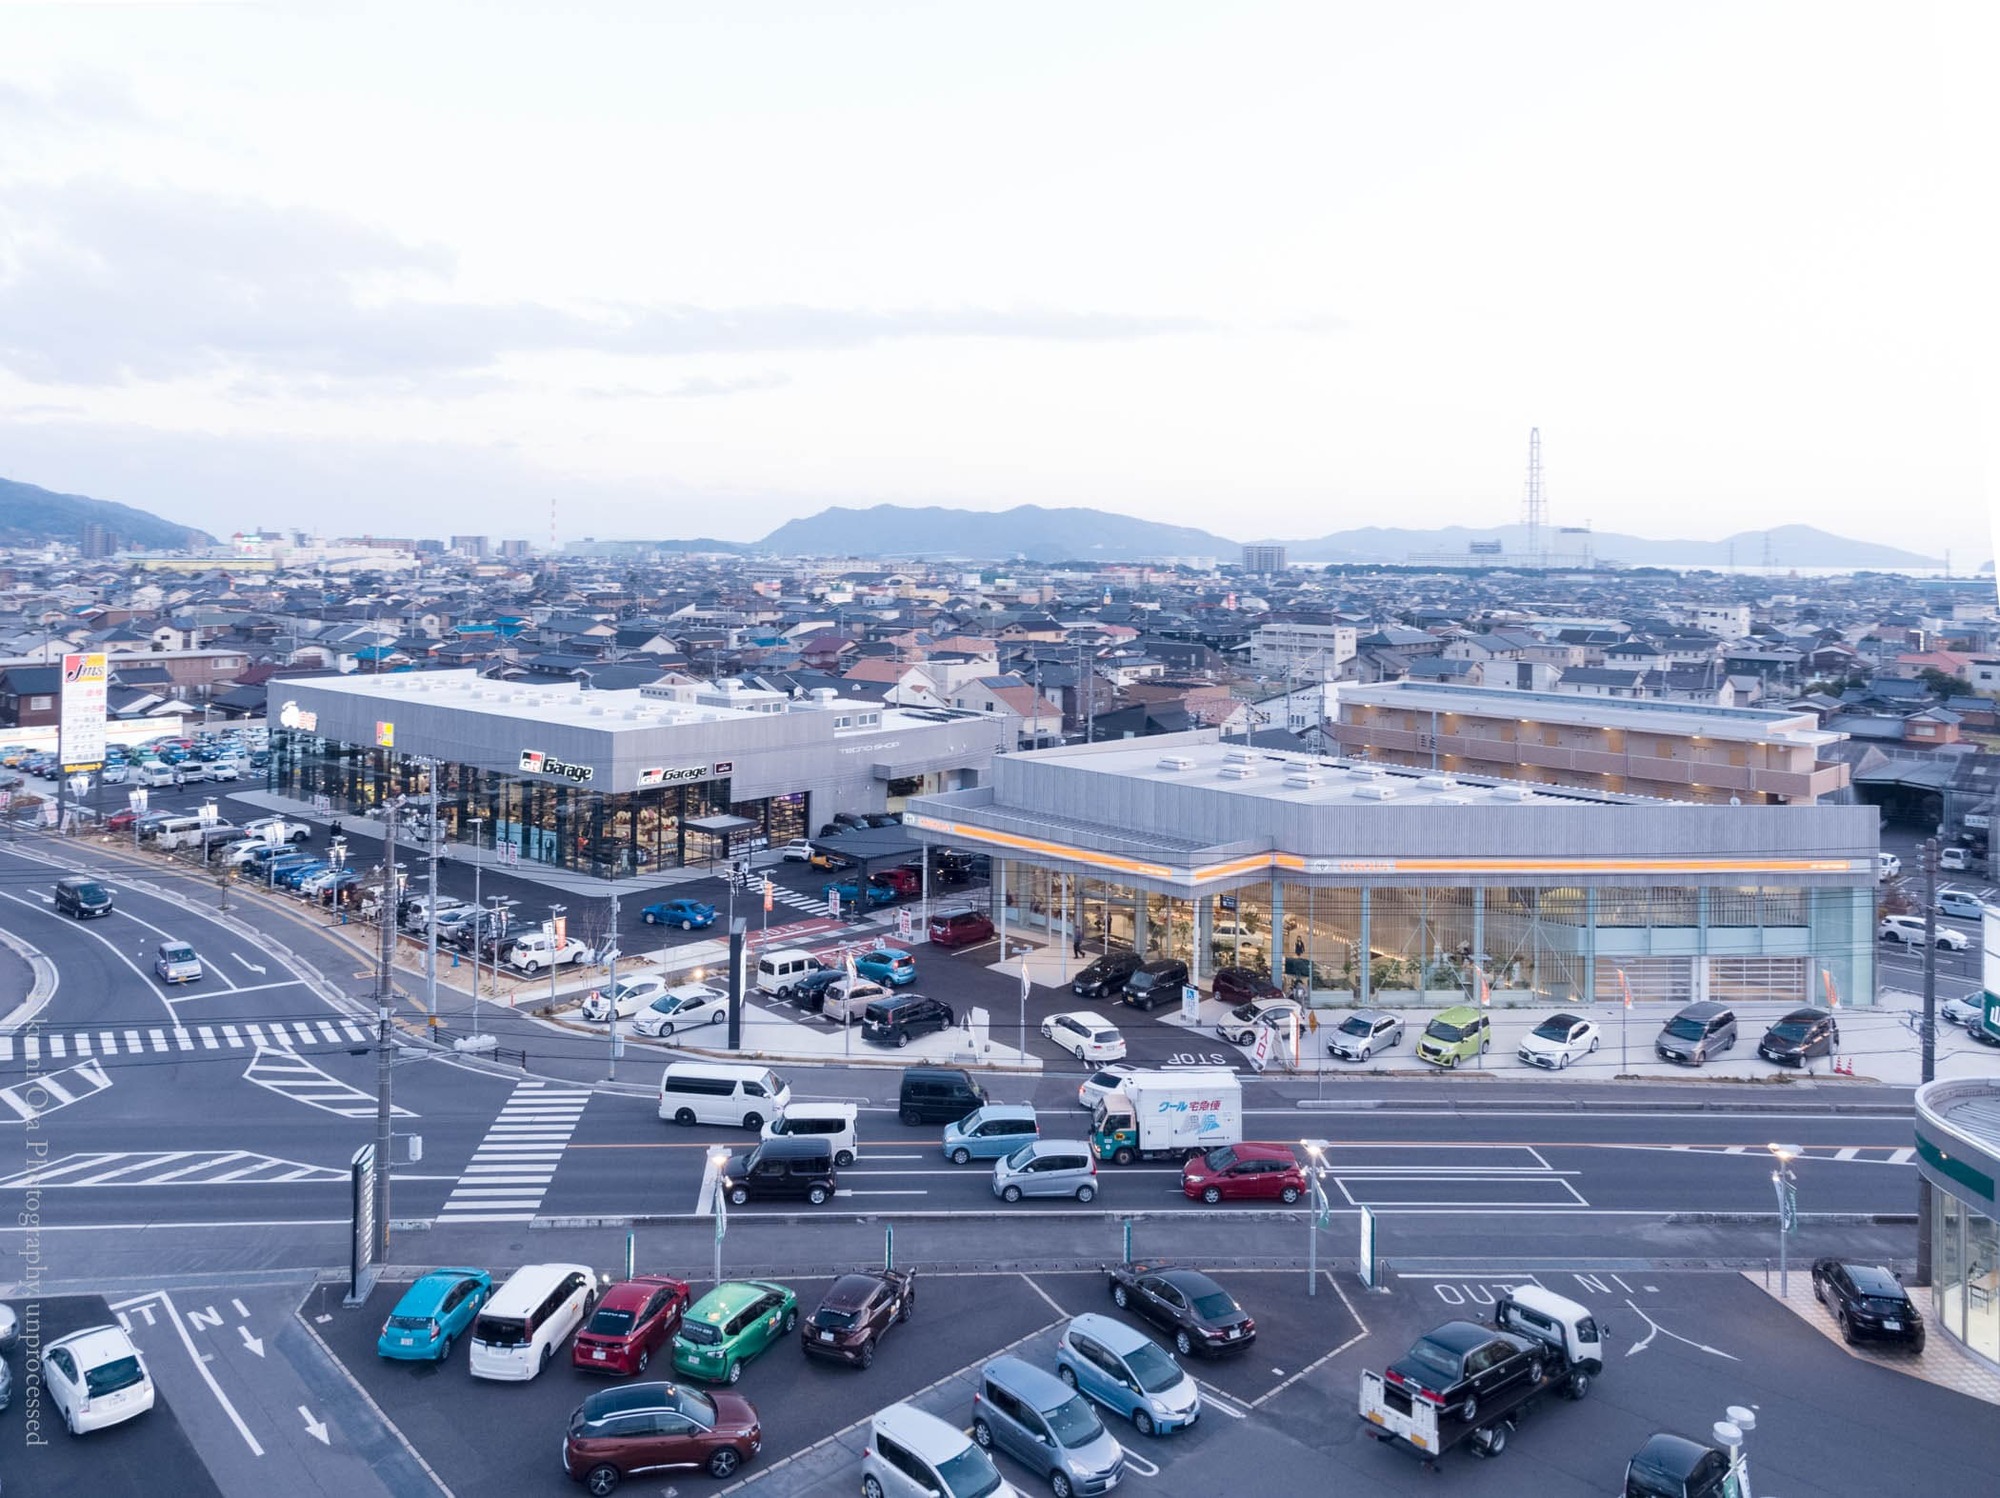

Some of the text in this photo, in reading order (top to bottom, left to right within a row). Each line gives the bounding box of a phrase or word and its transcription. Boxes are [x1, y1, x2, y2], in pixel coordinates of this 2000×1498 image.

[522, 757, 593, 782] GR Garage
[662, 766, 708, 781] Garage
[821, 946, 871, 961] SOP
[1167, 1053, 1227, 1066] STOP
